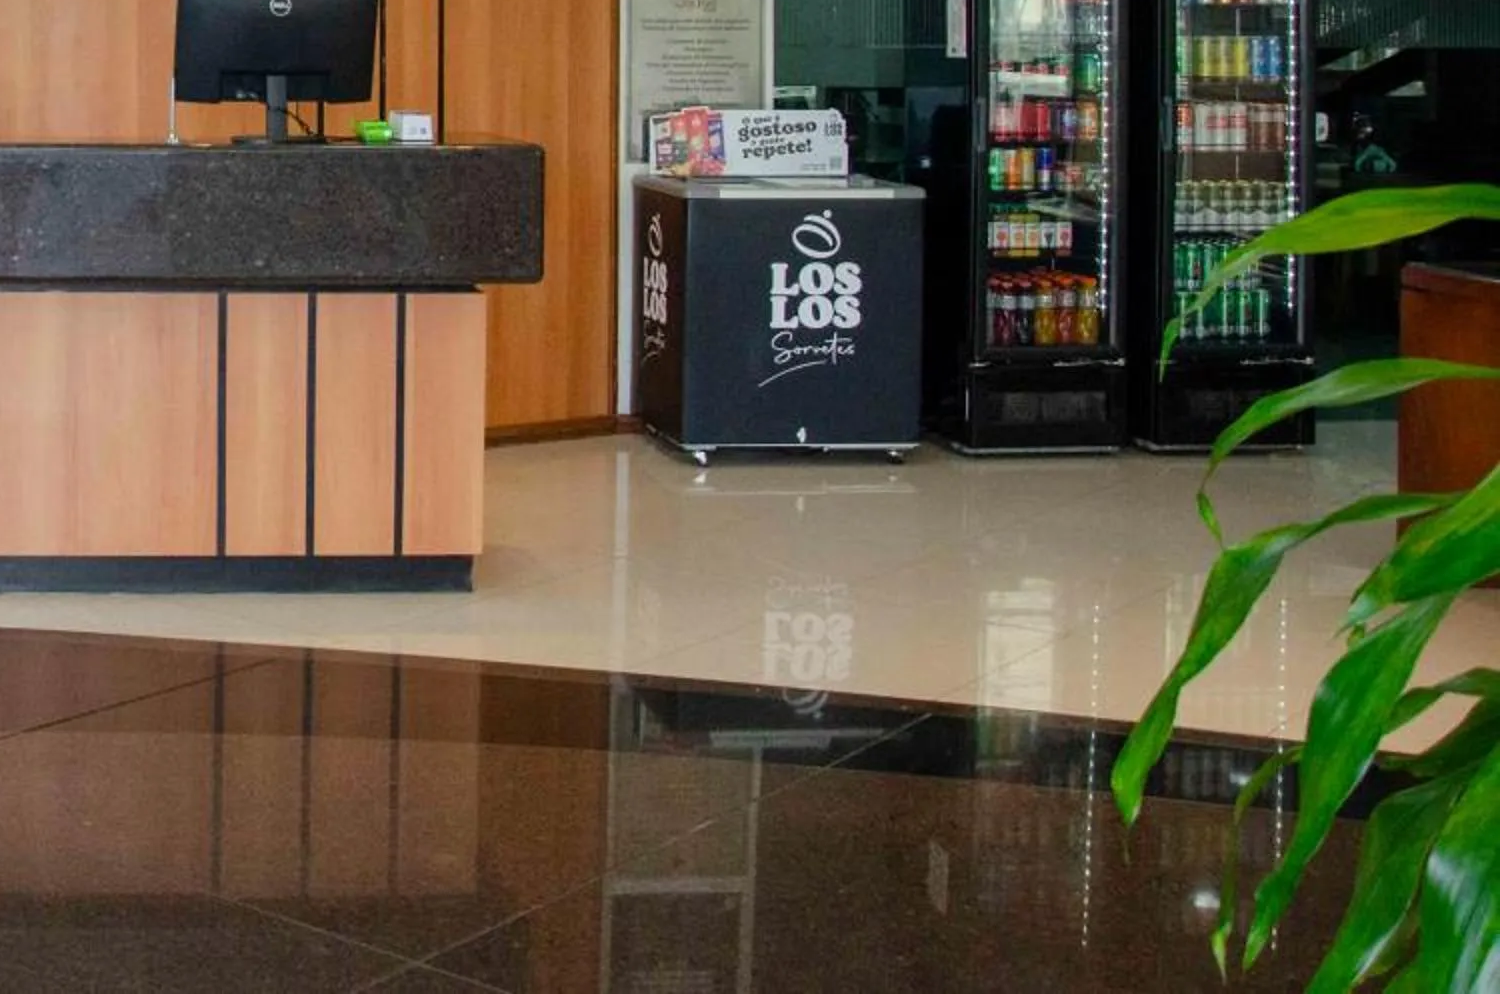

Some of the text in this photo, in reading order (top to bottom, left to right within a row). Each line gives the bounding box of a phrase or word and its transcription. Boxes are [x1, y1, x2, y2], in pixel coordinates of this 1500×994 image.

[738, 120, 817, 142] gostoso
[741, 138, 813, 159] repete!
[643, 256, 668, 293] LOS
[770, 261, 862, 296] LOS
[643, 288, 668, 325] LOS
[769, 295, 862, 329] LOS
[771, 331, 856, 365] Sorvetes
